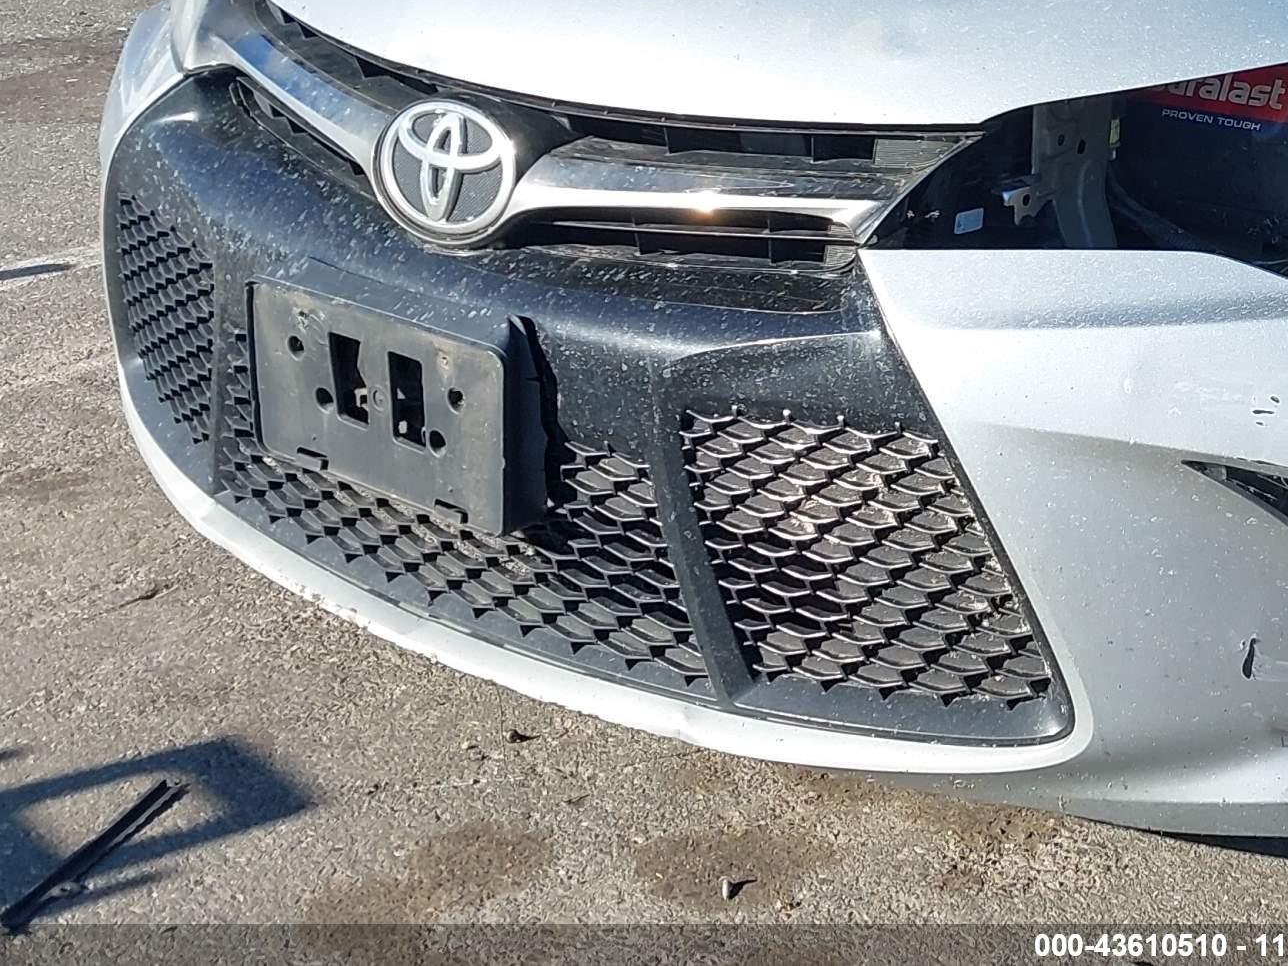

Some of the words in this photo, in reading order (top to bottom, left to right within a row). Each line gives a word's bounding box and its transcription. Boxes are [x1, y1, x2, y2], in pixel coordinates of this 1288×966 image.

[1148, 74, 1287, 111] uralast
[1161, 108, 1215, 124] PROVEN
[1217, 116, 1262, 131] TOUGH
